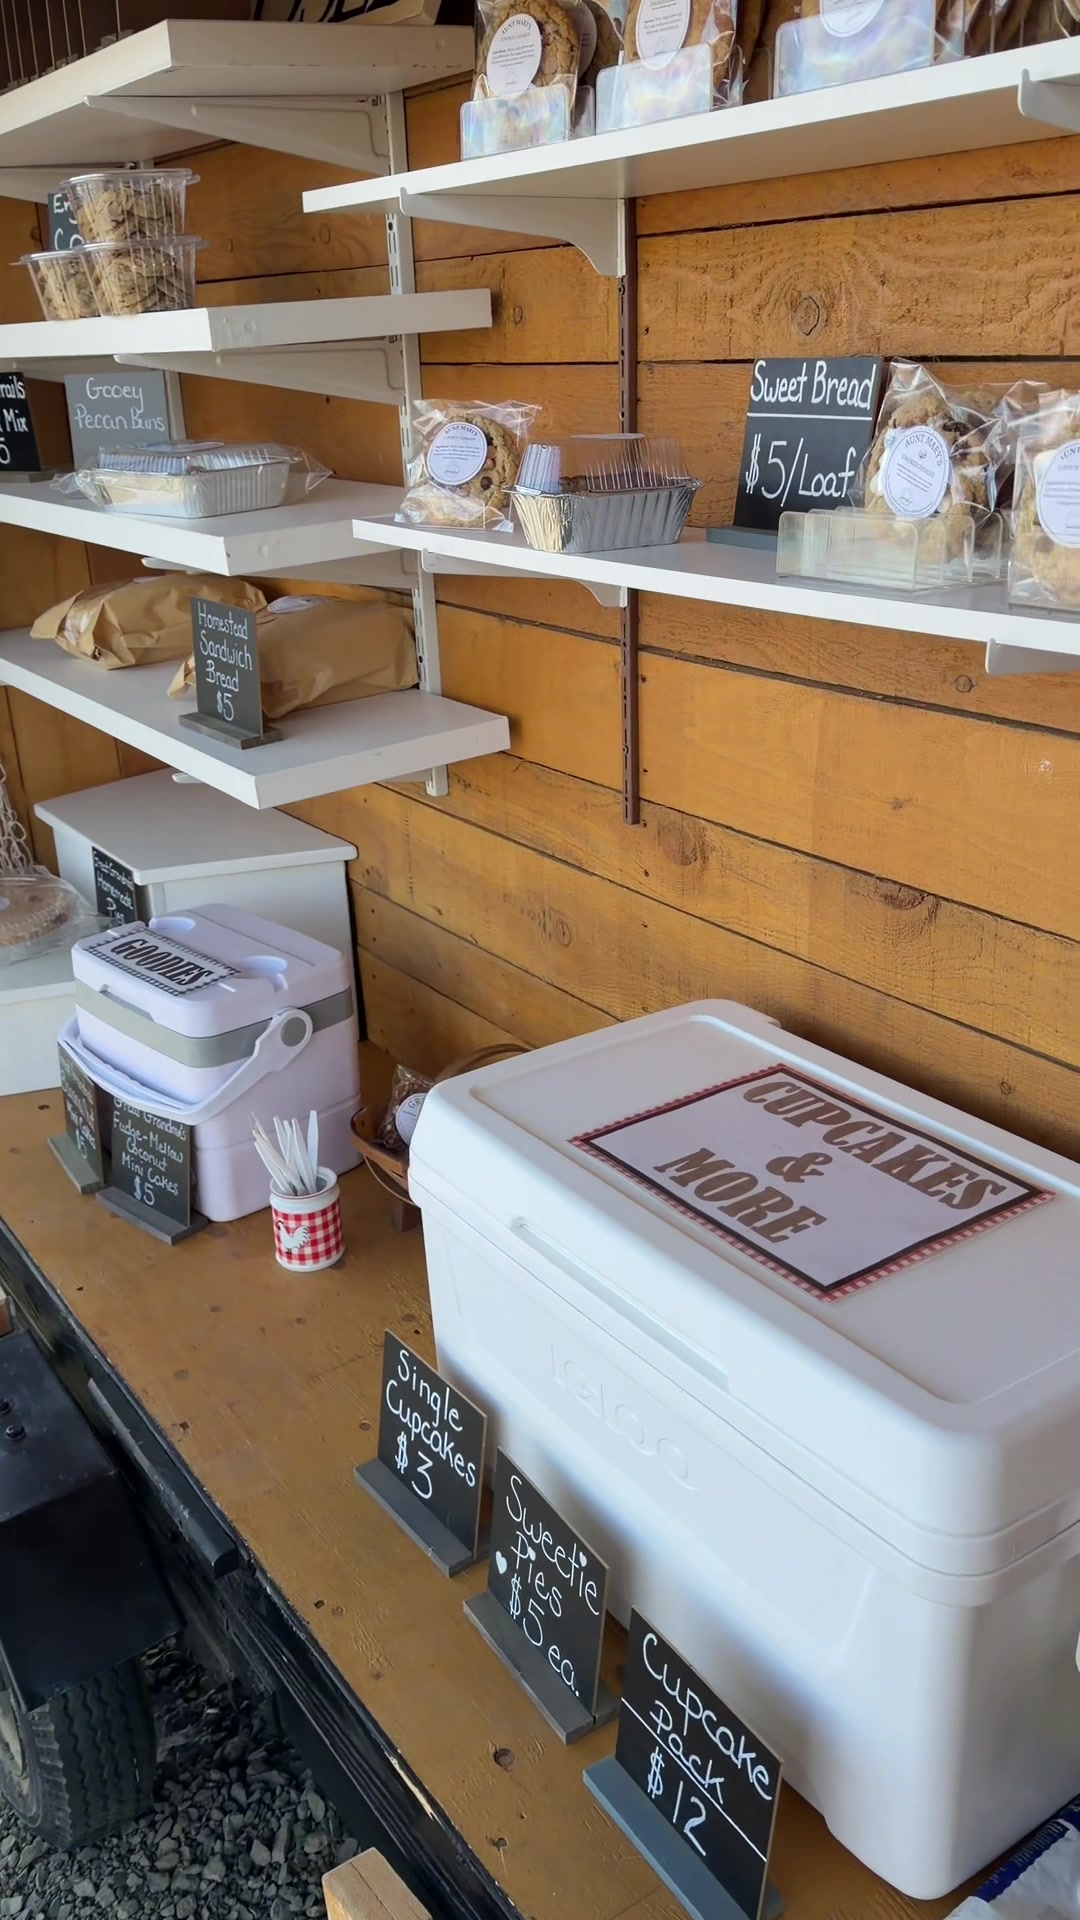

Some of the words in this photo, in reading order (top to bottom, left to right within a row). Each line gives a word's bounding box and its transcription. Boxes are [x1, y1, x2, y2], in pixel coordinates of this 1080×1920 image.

[86, 377, 144, 414] Gooey
[750, 360, 807, 403] Sweet
[811, 360, 877, 410] Bread
[3, 408, 29, 432] Mix
[74, 403, 128, 430] Pecan
[130, 405, 165, 432] Buns
[745, 433, 857, 507] $5/Loaf
[905, 433, 926, 448] AUNT
[925, 434, 944, 466] MARY'S
[197, 600, 248, 640] Homestead
[200, 630, 253, 671] Sandwich
[206, 659, 239, 692] Bread
[216, 690, 235, 721] $5
[110, 938, 215, 986] GOODIES
[126, 1137, 167, 1172] Coconut
[743, 1080, 1007, 1210] CUPCAKES
[765, 1151, 833, 1184] &
[121, 1151, 144, 1177] Mini
[147, 1167, 179, 1197] Cakes
[133, 1175, 155, 1206] $5
[653, 1147, 828, 1244] MORE
[397, 1349, 463, 1433] Single
[385, 1379, 477, 1488] Cupcakes
[506, 1475, 601, 1616] Sweetie
[511, 1530, 564, 1618] Pies
[547, 1643, 581, 1697] ea.
[641, 1632, 774, 1803] Cupcake
[649, 1699, 725, 1806] Pack
